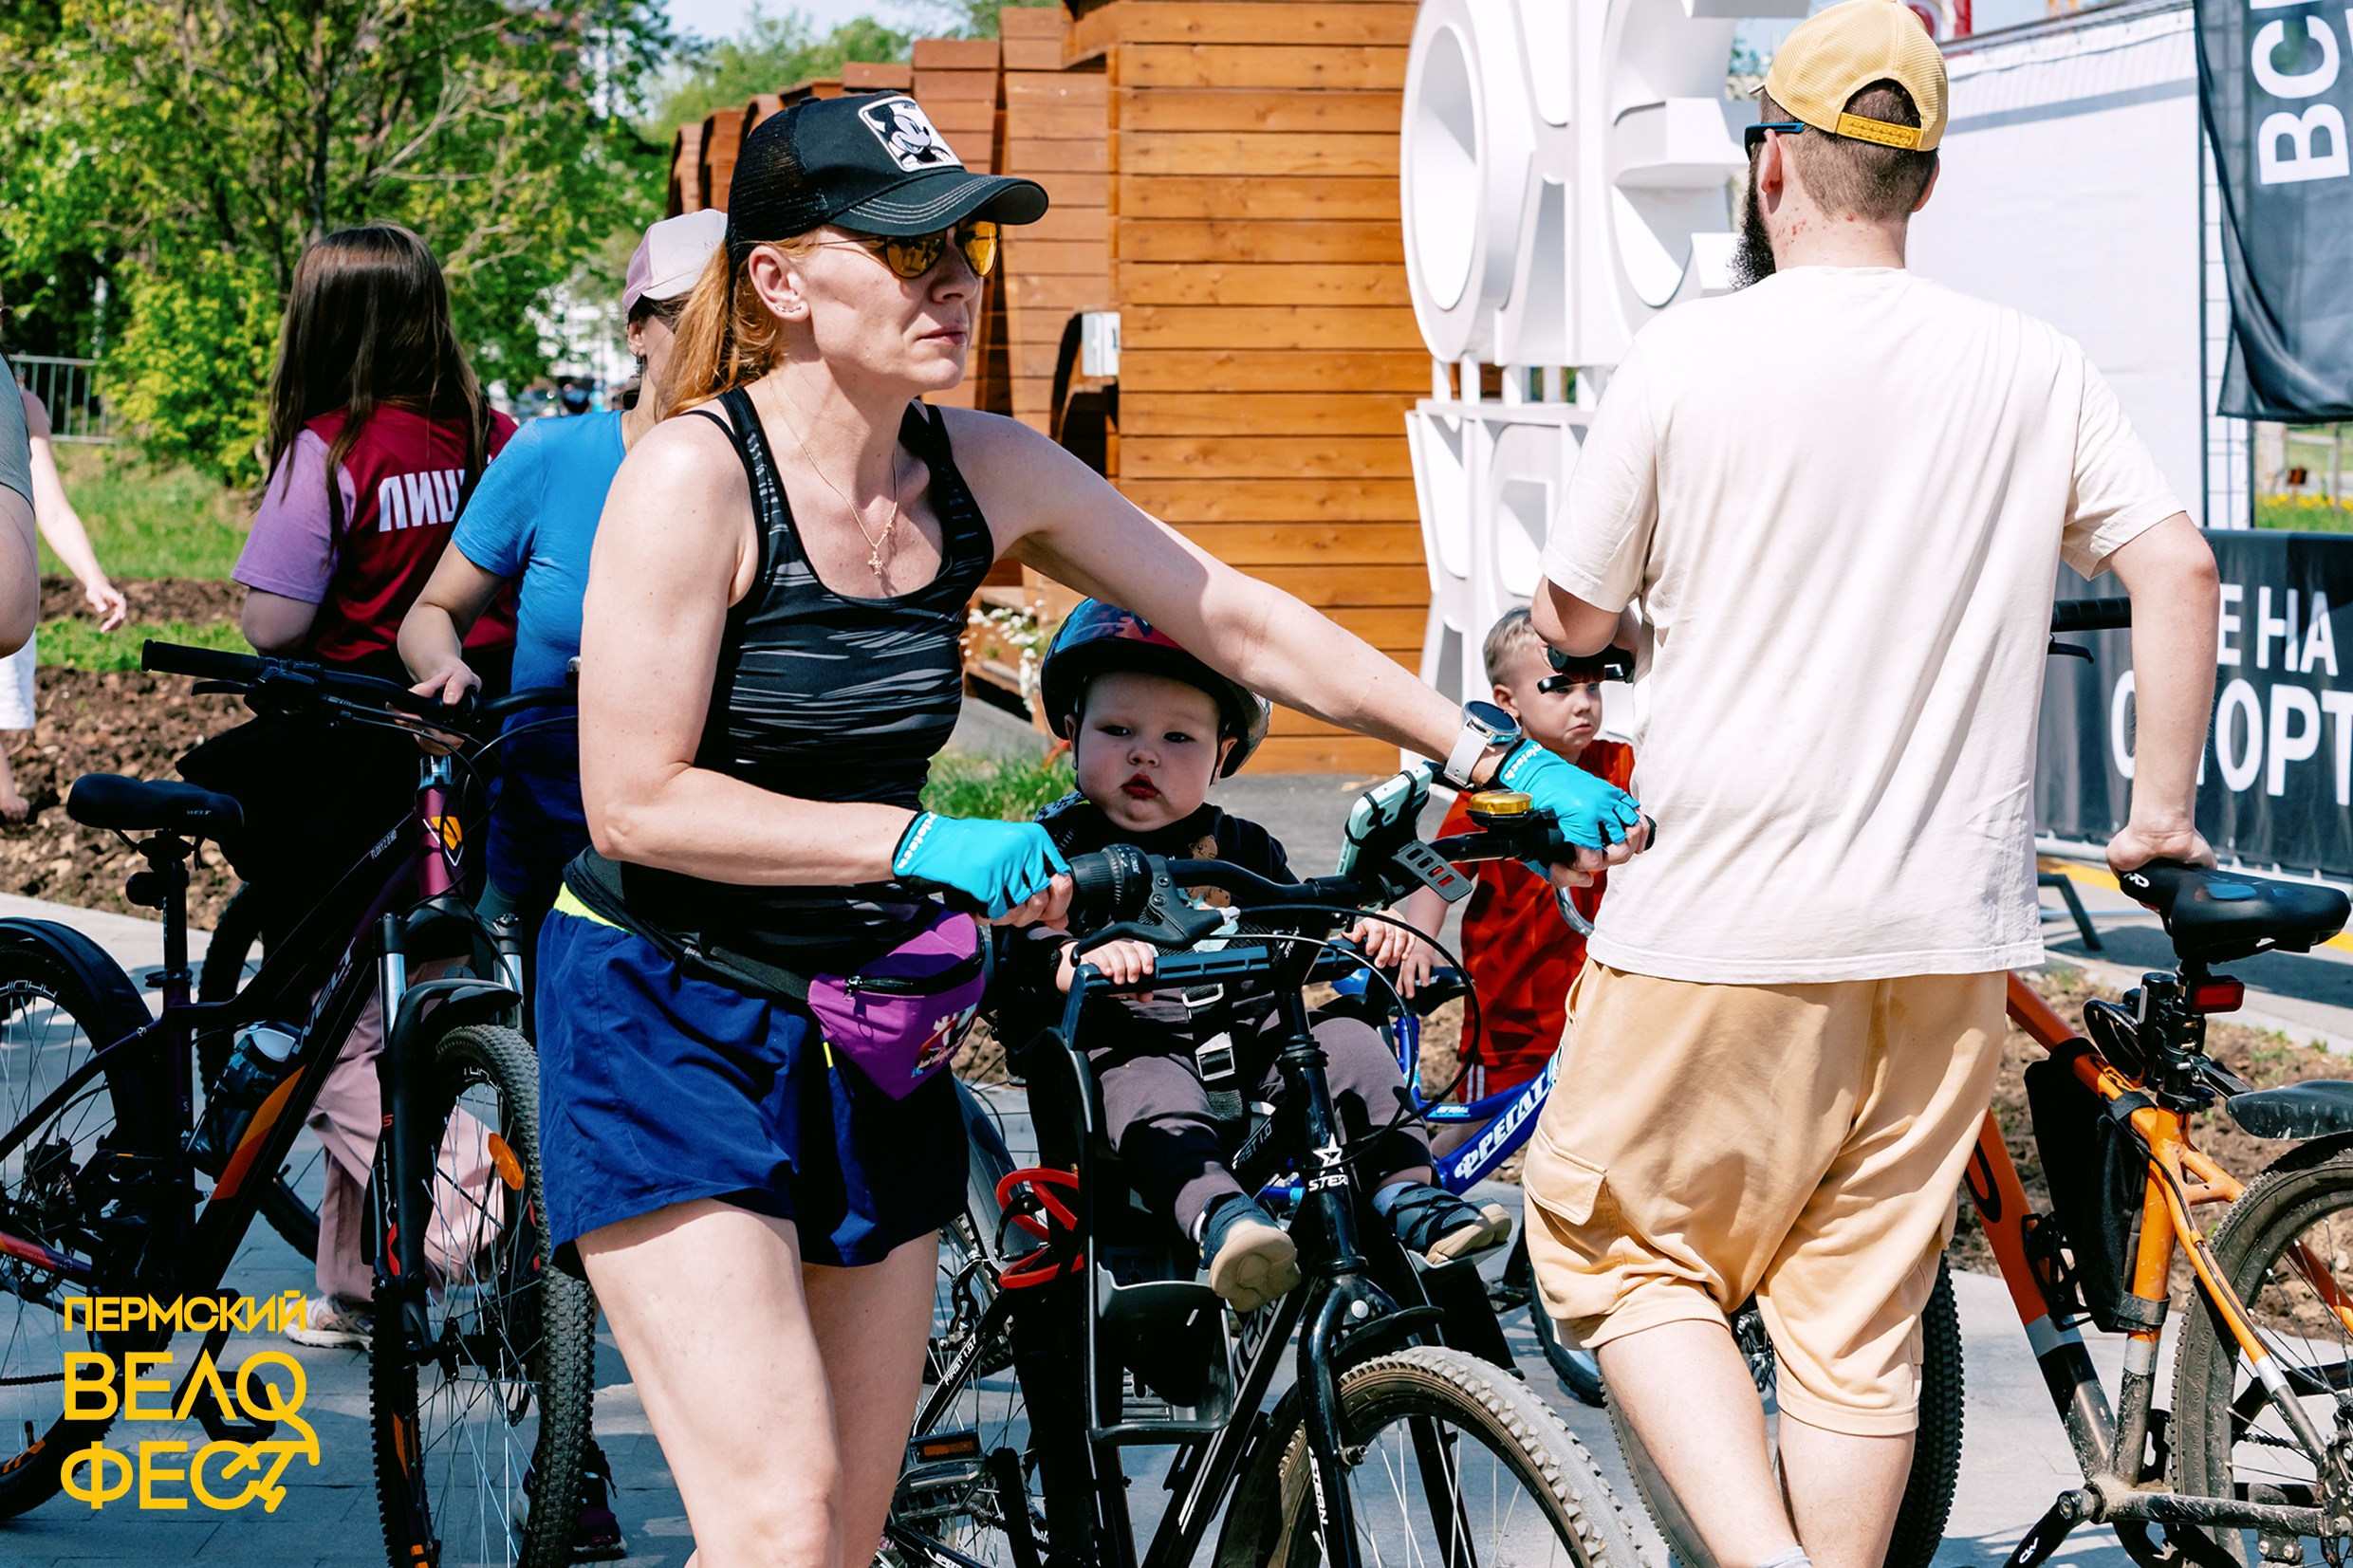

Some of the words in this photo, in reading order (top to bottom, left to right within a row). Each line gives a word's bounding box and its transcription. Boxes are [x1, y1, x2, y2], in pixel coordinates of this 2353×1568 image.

[2250, 0, 2350, 185] ВС
[2256, 585, 2339, 677] НА
[2111, 670, 2353, 807] СОРТ
[292, 936, 357, 1055] WELT
[1454, 1071, 1547, 1180] ФРЕГАТ
